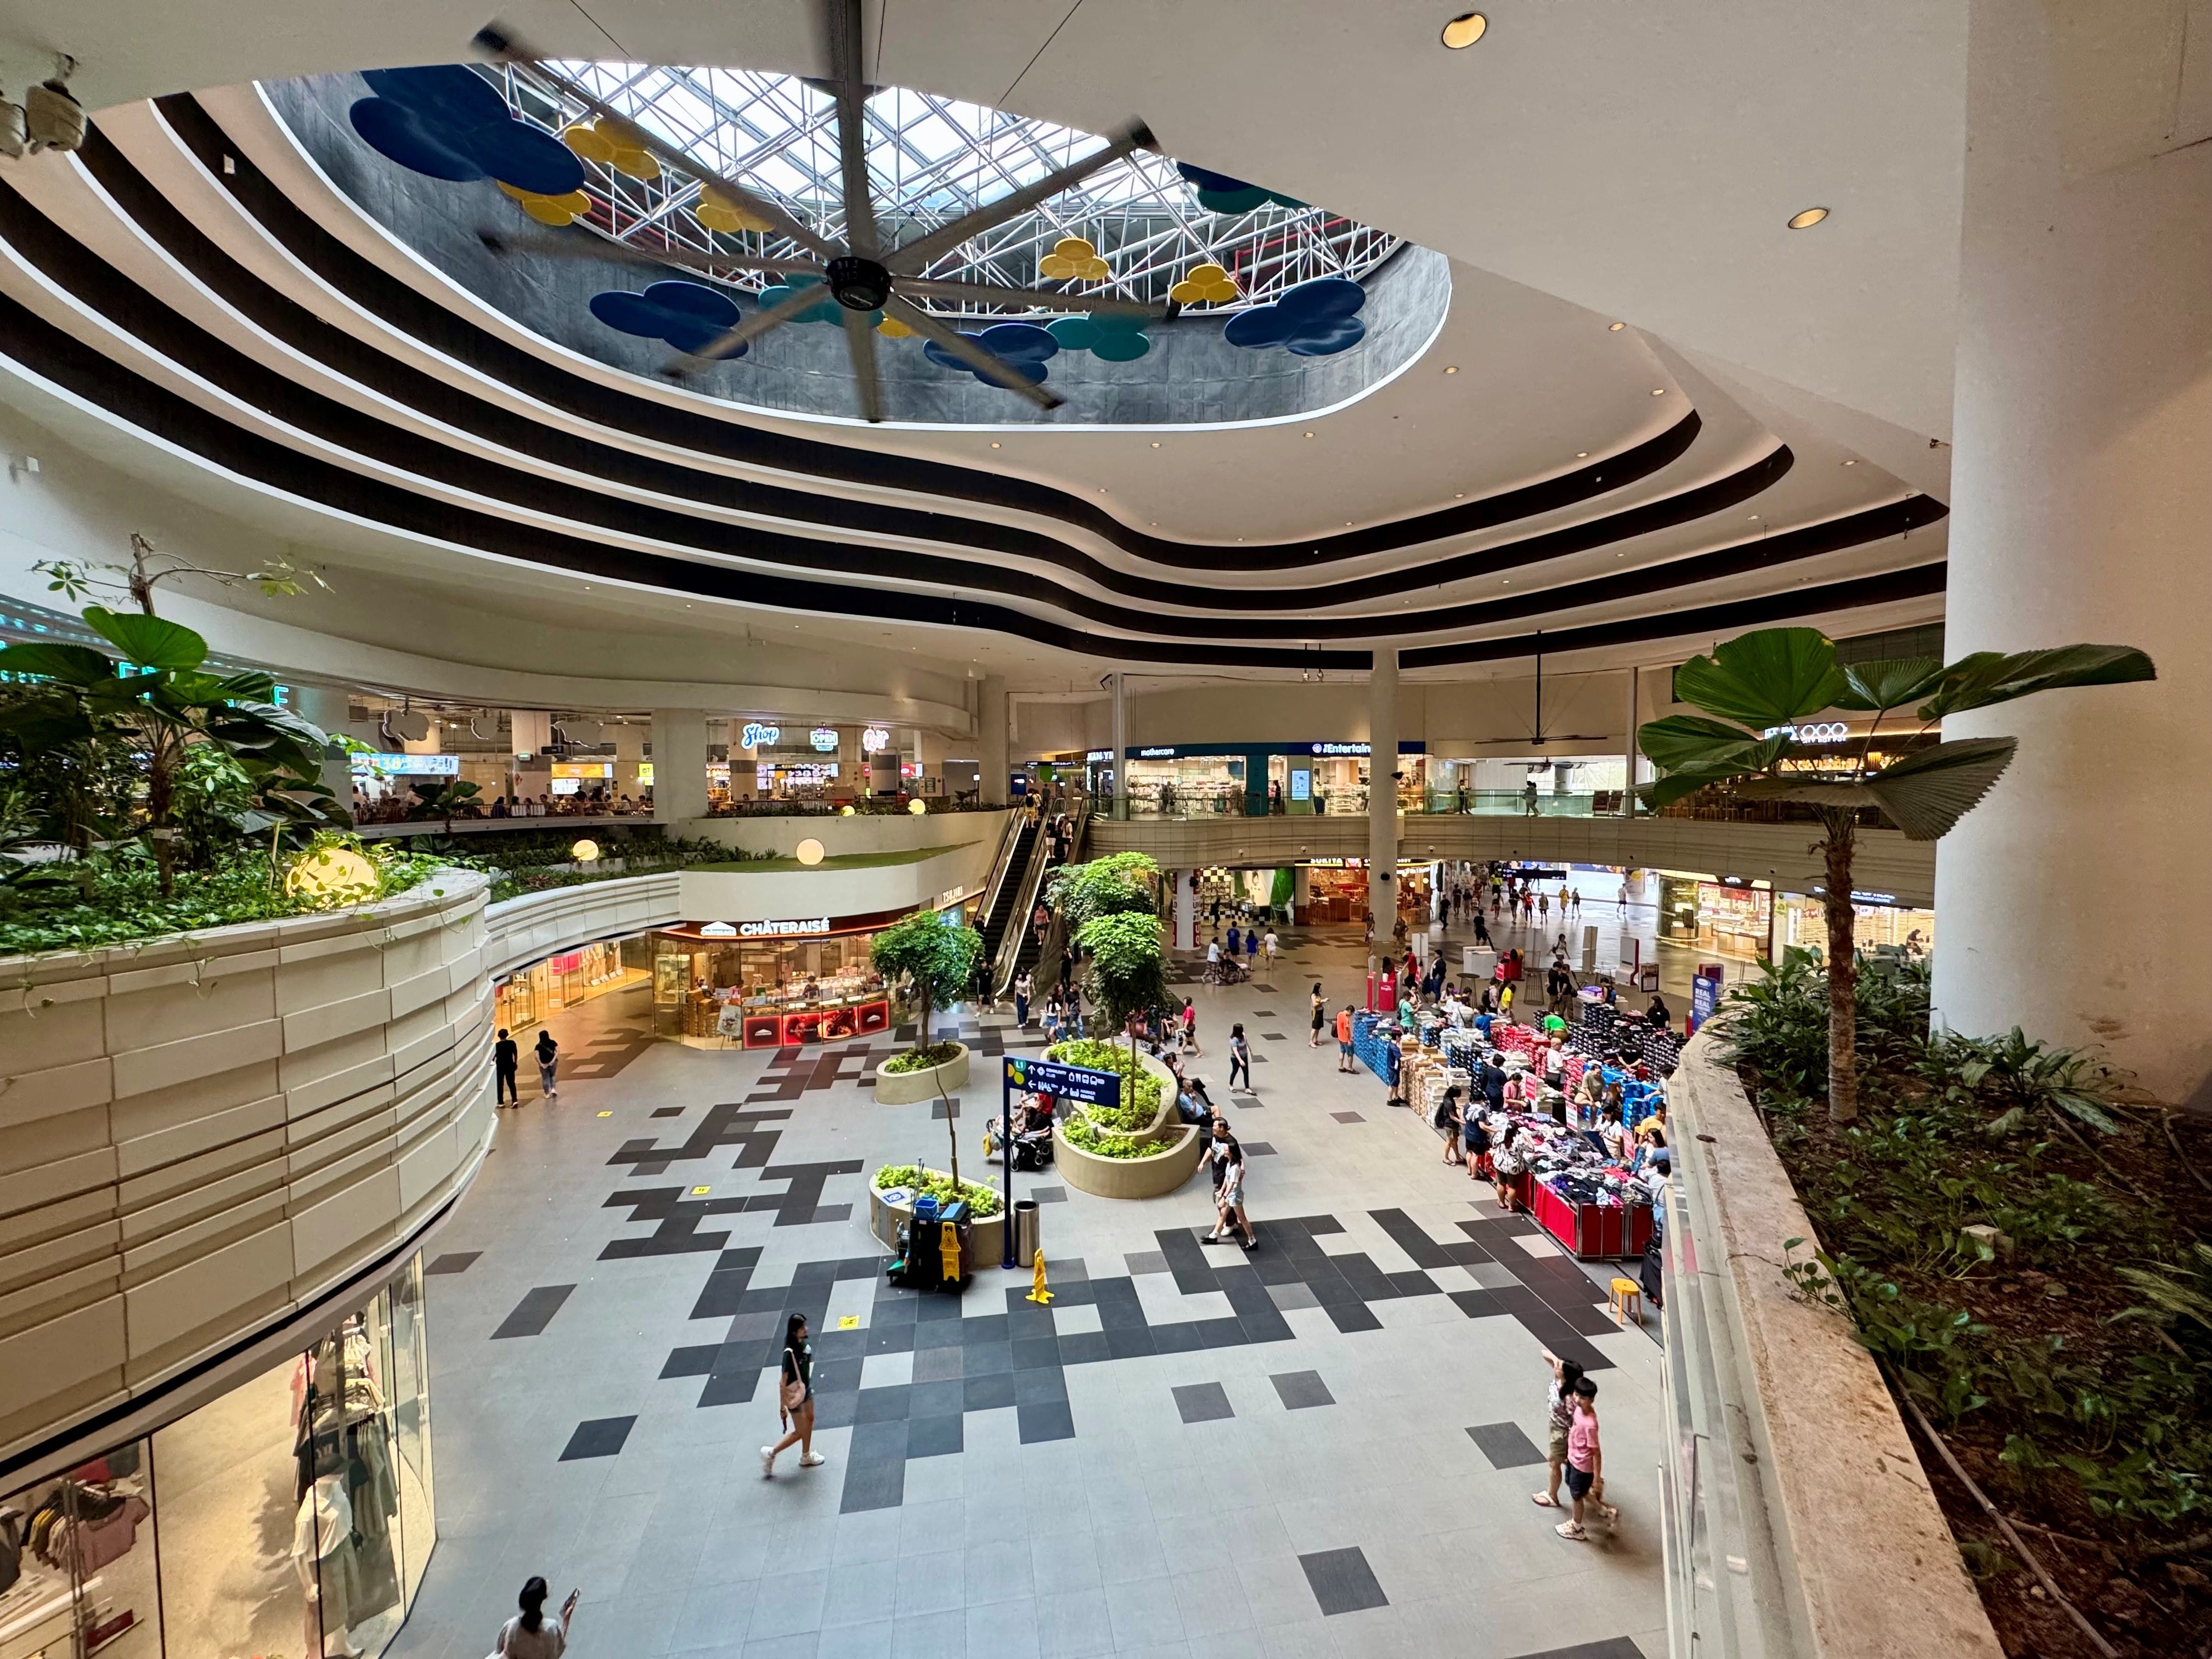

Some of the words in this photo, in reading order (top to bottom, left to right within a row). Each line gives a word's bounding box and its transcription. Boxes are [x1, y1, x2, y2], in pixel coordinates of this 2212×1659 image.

[743, 724, 778, 747] Shop
[813, 734, 836, 743] OPEN
[1086, 752, 1103, 761] JEAN
[1141, 748, 1175, 757] mothercare
[740, 917, 830, 936] CHÂTERAISÉ
[1695, 988, 1711, 998] REAL
[1694, 998, 1711, 1009] REAL
[1015, 1061, 1024, 1069] L1
